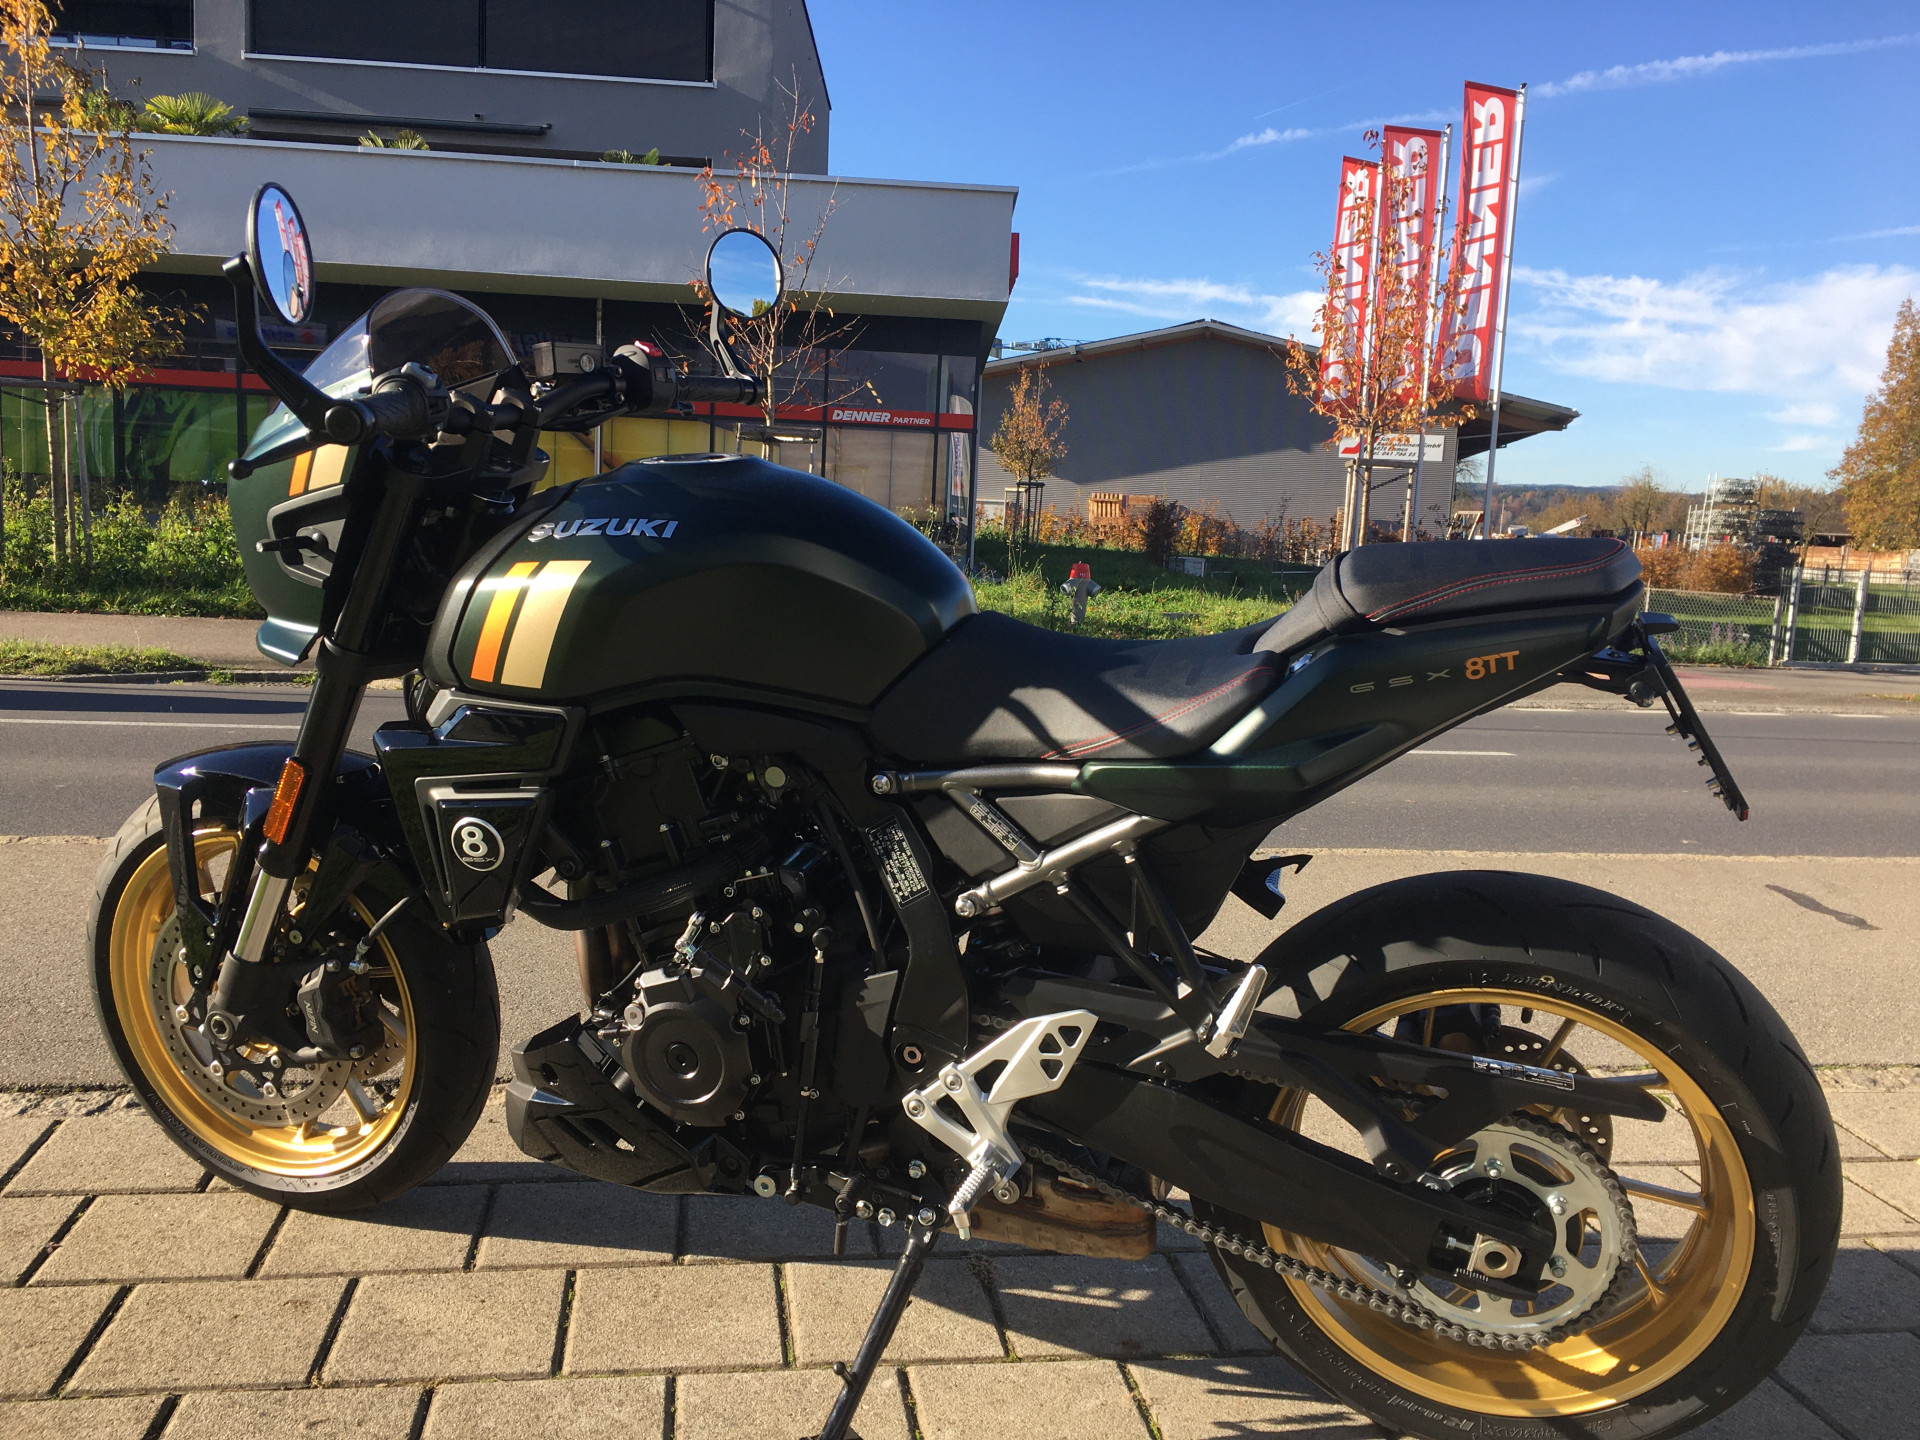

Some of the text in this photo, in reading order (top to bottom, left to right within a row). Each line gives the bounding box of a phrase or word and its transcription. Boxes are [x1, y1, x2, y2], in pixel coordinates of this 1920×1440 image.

[832, 410, 931, 425] DENNER PARTNER
[528, 518, 679, 543] SUZUKI
[1350, 650, 1520, 693] GSX 8TT
[461, 826, 488, 857] 8
